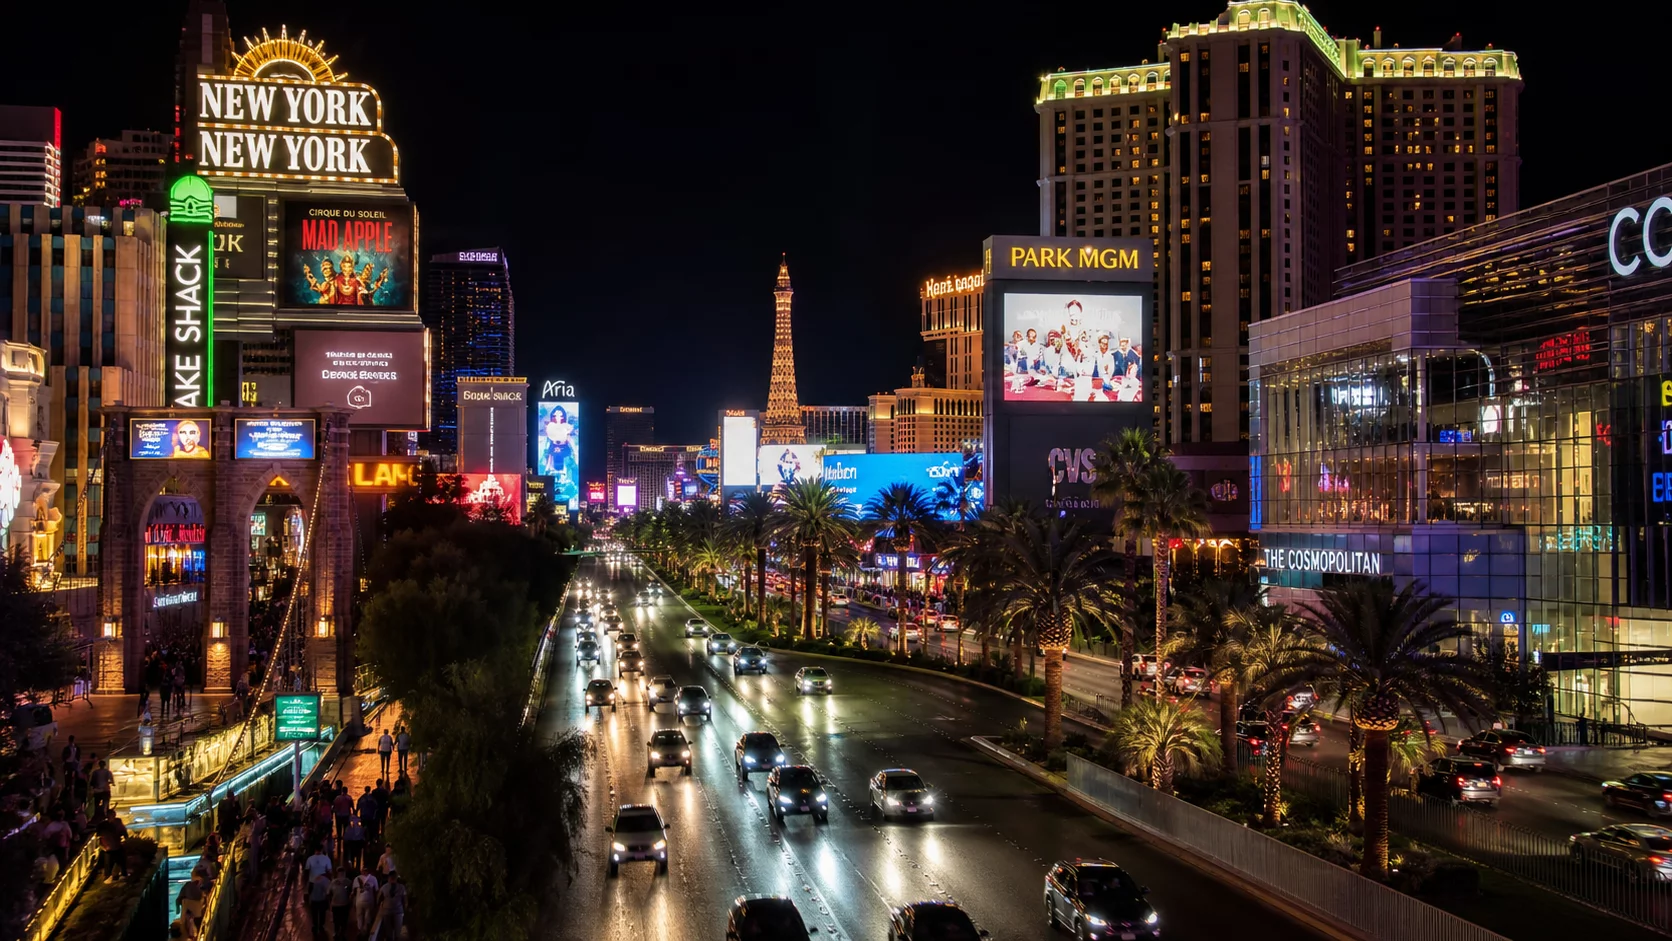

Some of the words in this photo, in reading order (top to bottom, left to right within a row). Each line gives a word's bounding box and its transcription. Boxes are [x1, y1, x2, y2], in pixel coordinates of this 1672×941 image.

[199, 82, 277, 122] NEW
[283, 87, 372, 127] YORK
[199, 131, 277, 169] NEW
[283, 134, 372, 173] YORK
[308, 208, 341, 218] CIRQUE
[343, 209, 356, 218] DU
[357, 210, 387, 219] SOLEIL
[302, 219, 339, 251] MAD
[343, 221, 393, 253] APPLE
[1608, 196, 1672, 276] CO
[1011, 247, 1073, 268] PARK
[1079, 248, 1139, 270] MGM
[174, 244, 202, 343] SHACK
[541, 380, 576, 399] Aria
[1048, 447, 1097, 484] CVS
[1264, 549, 1285, 568] THE
[1288, 550, 1380, 575] COSMOPOLITAN
